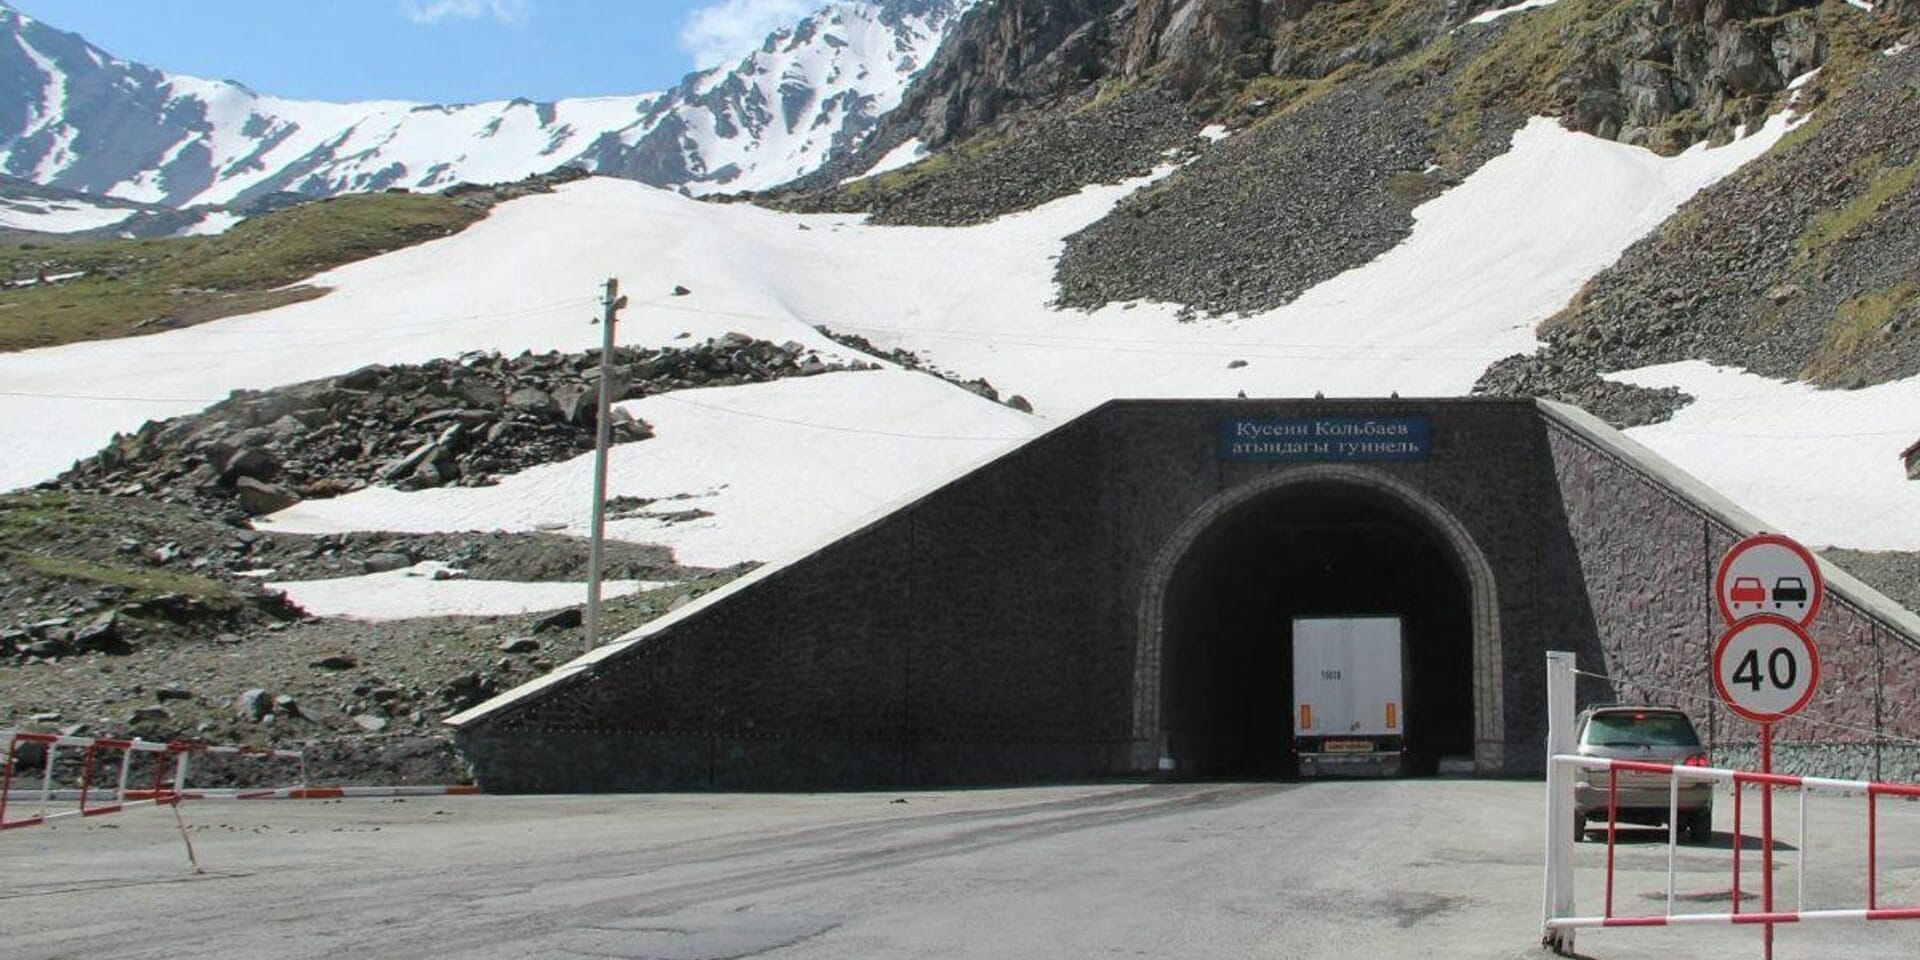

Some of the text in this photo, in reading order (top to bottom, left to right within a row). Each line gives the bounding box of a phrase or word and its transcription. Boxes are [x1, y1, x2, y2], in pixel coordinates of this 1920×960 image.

[1315, 421, 1408, 435] Кольбаев
[1232, 442, 1420, 456] атындагы туннель
[1732, 647, 1796, 691] 40
